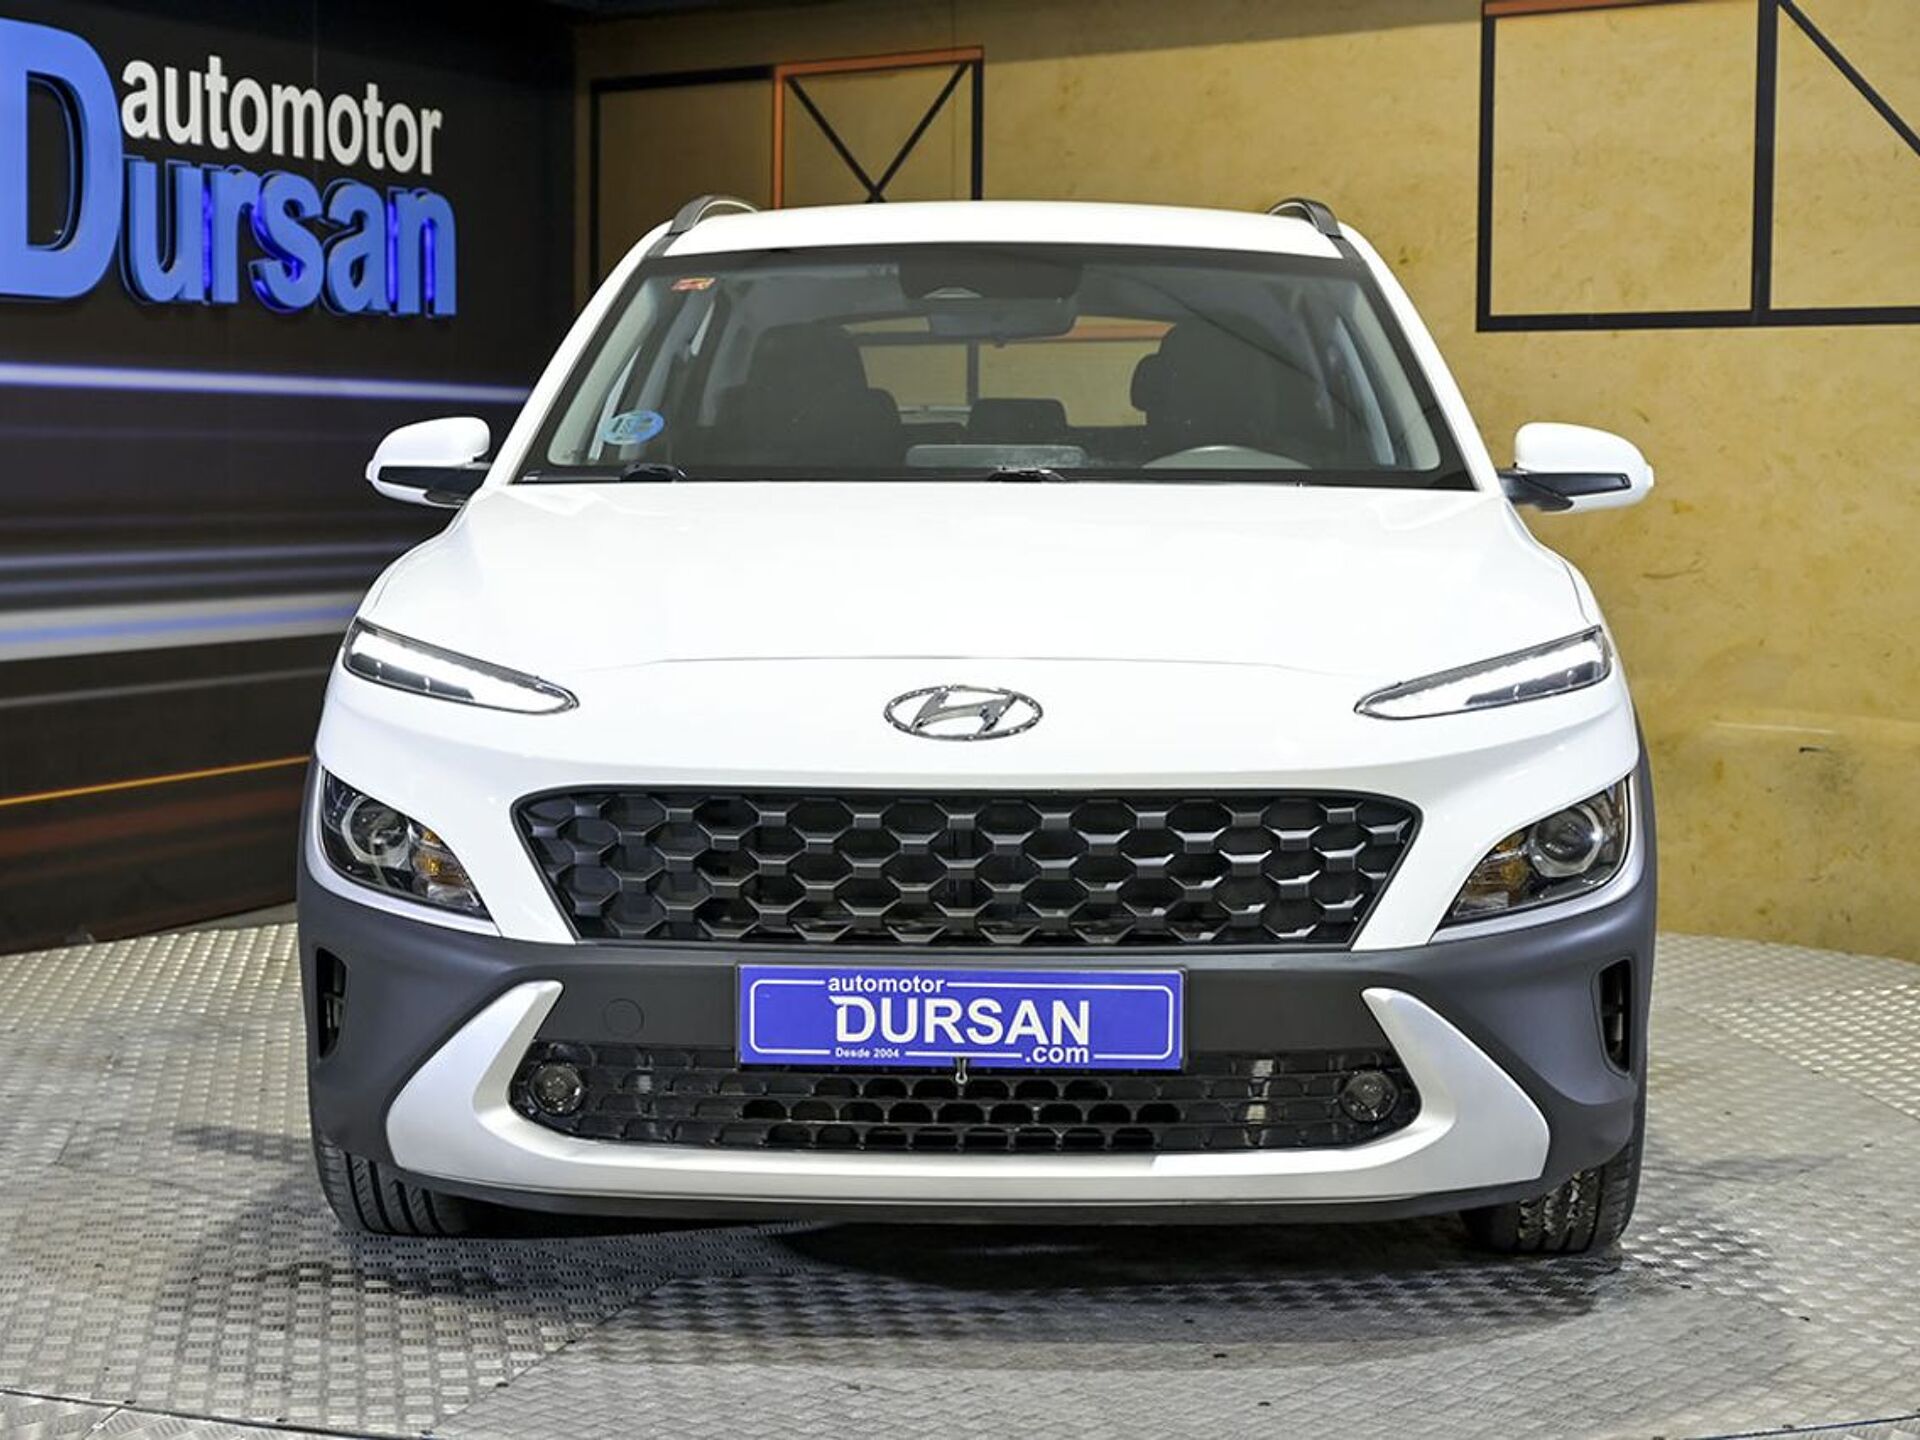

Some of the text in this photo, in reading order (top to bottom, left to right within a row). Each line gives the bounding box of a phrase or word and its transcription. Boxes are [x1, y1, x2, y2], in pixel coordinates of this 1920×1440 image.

[122, 55, 443, 175] automotor
[0, 17, 457, 318] Dursan
[828, 974, 945, 993] automotor
[829, 996, 1090, 1045] DURSAN
[835, 1047, 900, 1058] Desde 2004
[1025, 1046, 1088, 1064] .com
